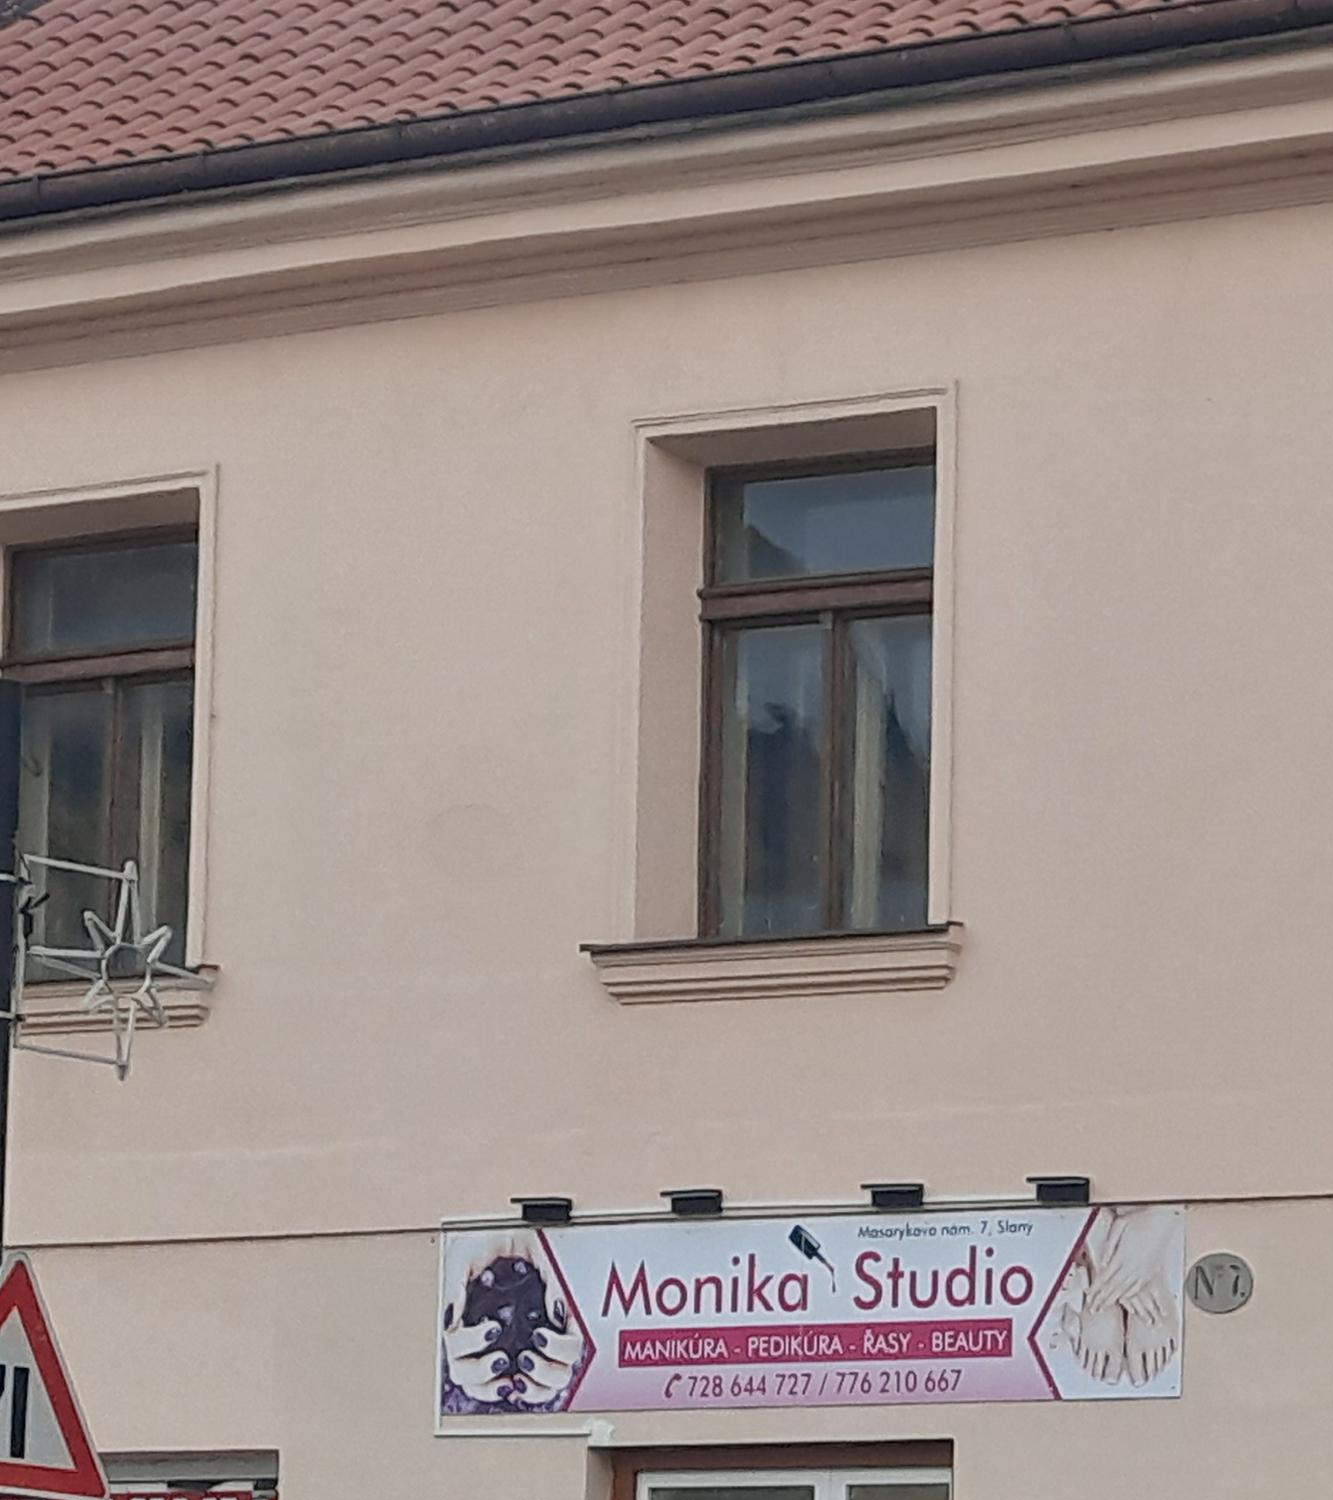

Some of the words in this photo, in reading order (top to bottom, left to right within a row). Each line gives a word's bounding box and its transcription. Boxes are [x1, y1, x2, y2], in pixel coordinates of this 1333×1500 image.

[601, 1253, 808, 1317] Monika
[853, 1245, 1033, 1311] Studio
[624, 1332, 728, 1361] MANIKÚRA
[747, 1329, 843, 1358] PEDIKÚRA
[863, 1328, 912, 1354] ŘASY
[931, 1330, 1008, 1352] BEAUTY
[688, 1375, 722, 1397] 728
[731, 1373, 767, 1396] 644
[776, 1373, 811, 1395] 727
[836, 1372, 872, 1394] 776
[879, 1371, 917, 1393] 210
[924, 1369, 962, 1392] 667
